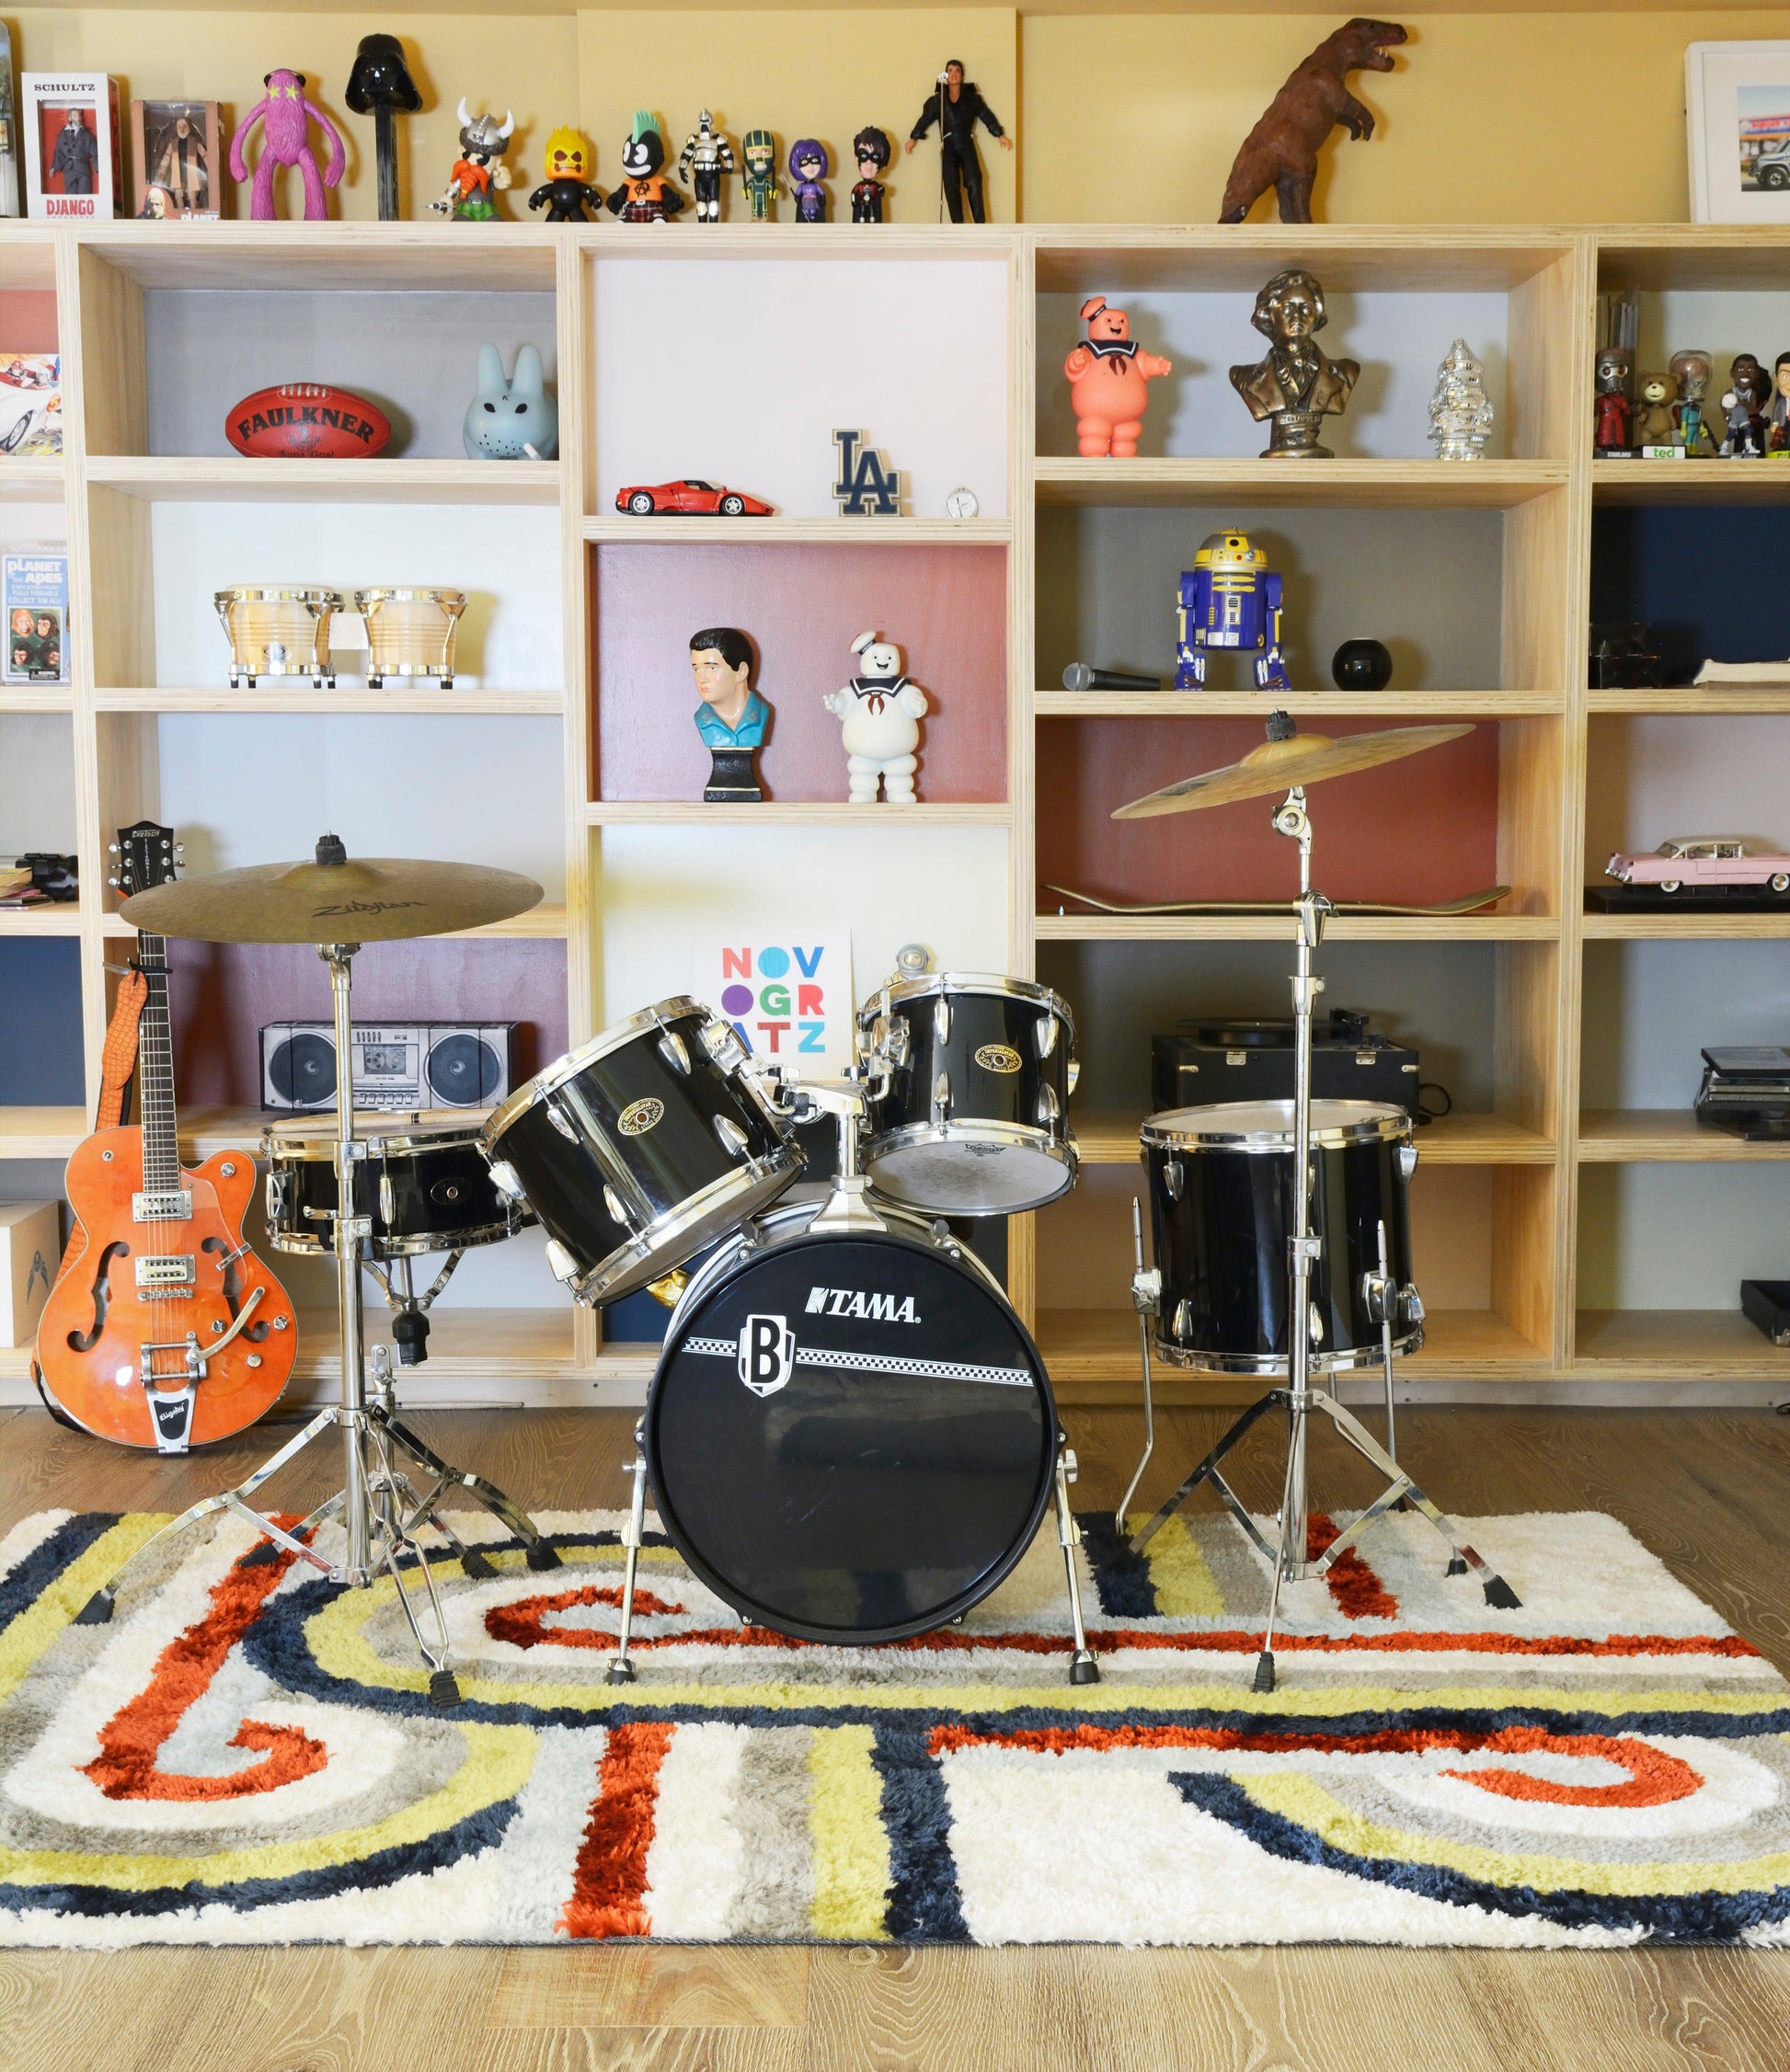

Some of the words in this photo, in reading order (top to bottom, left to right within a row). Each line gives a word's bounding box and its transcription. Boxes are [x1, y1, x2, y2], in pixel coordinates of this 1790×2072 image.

[34, 84, 96, 92] SCHULTZ
[46, 200, 95, 215] DJANGO
[237, 406, 375, 443] FAULKNER
[1653, 447, 1675, 458] ted
[832, 429, 901, 517] LA
[132, 830, 161, 838] GRETSCH
[311, 900, 428, 917] Zildjian
[722, 946, 824, 979] NOV
[721, 984, 825, 1016] OGR
[826, 1288, 915, 1322] TAMA
[750, 1318, 781, 1383] B
[159, 1403, 185, 1421] Bigsby
